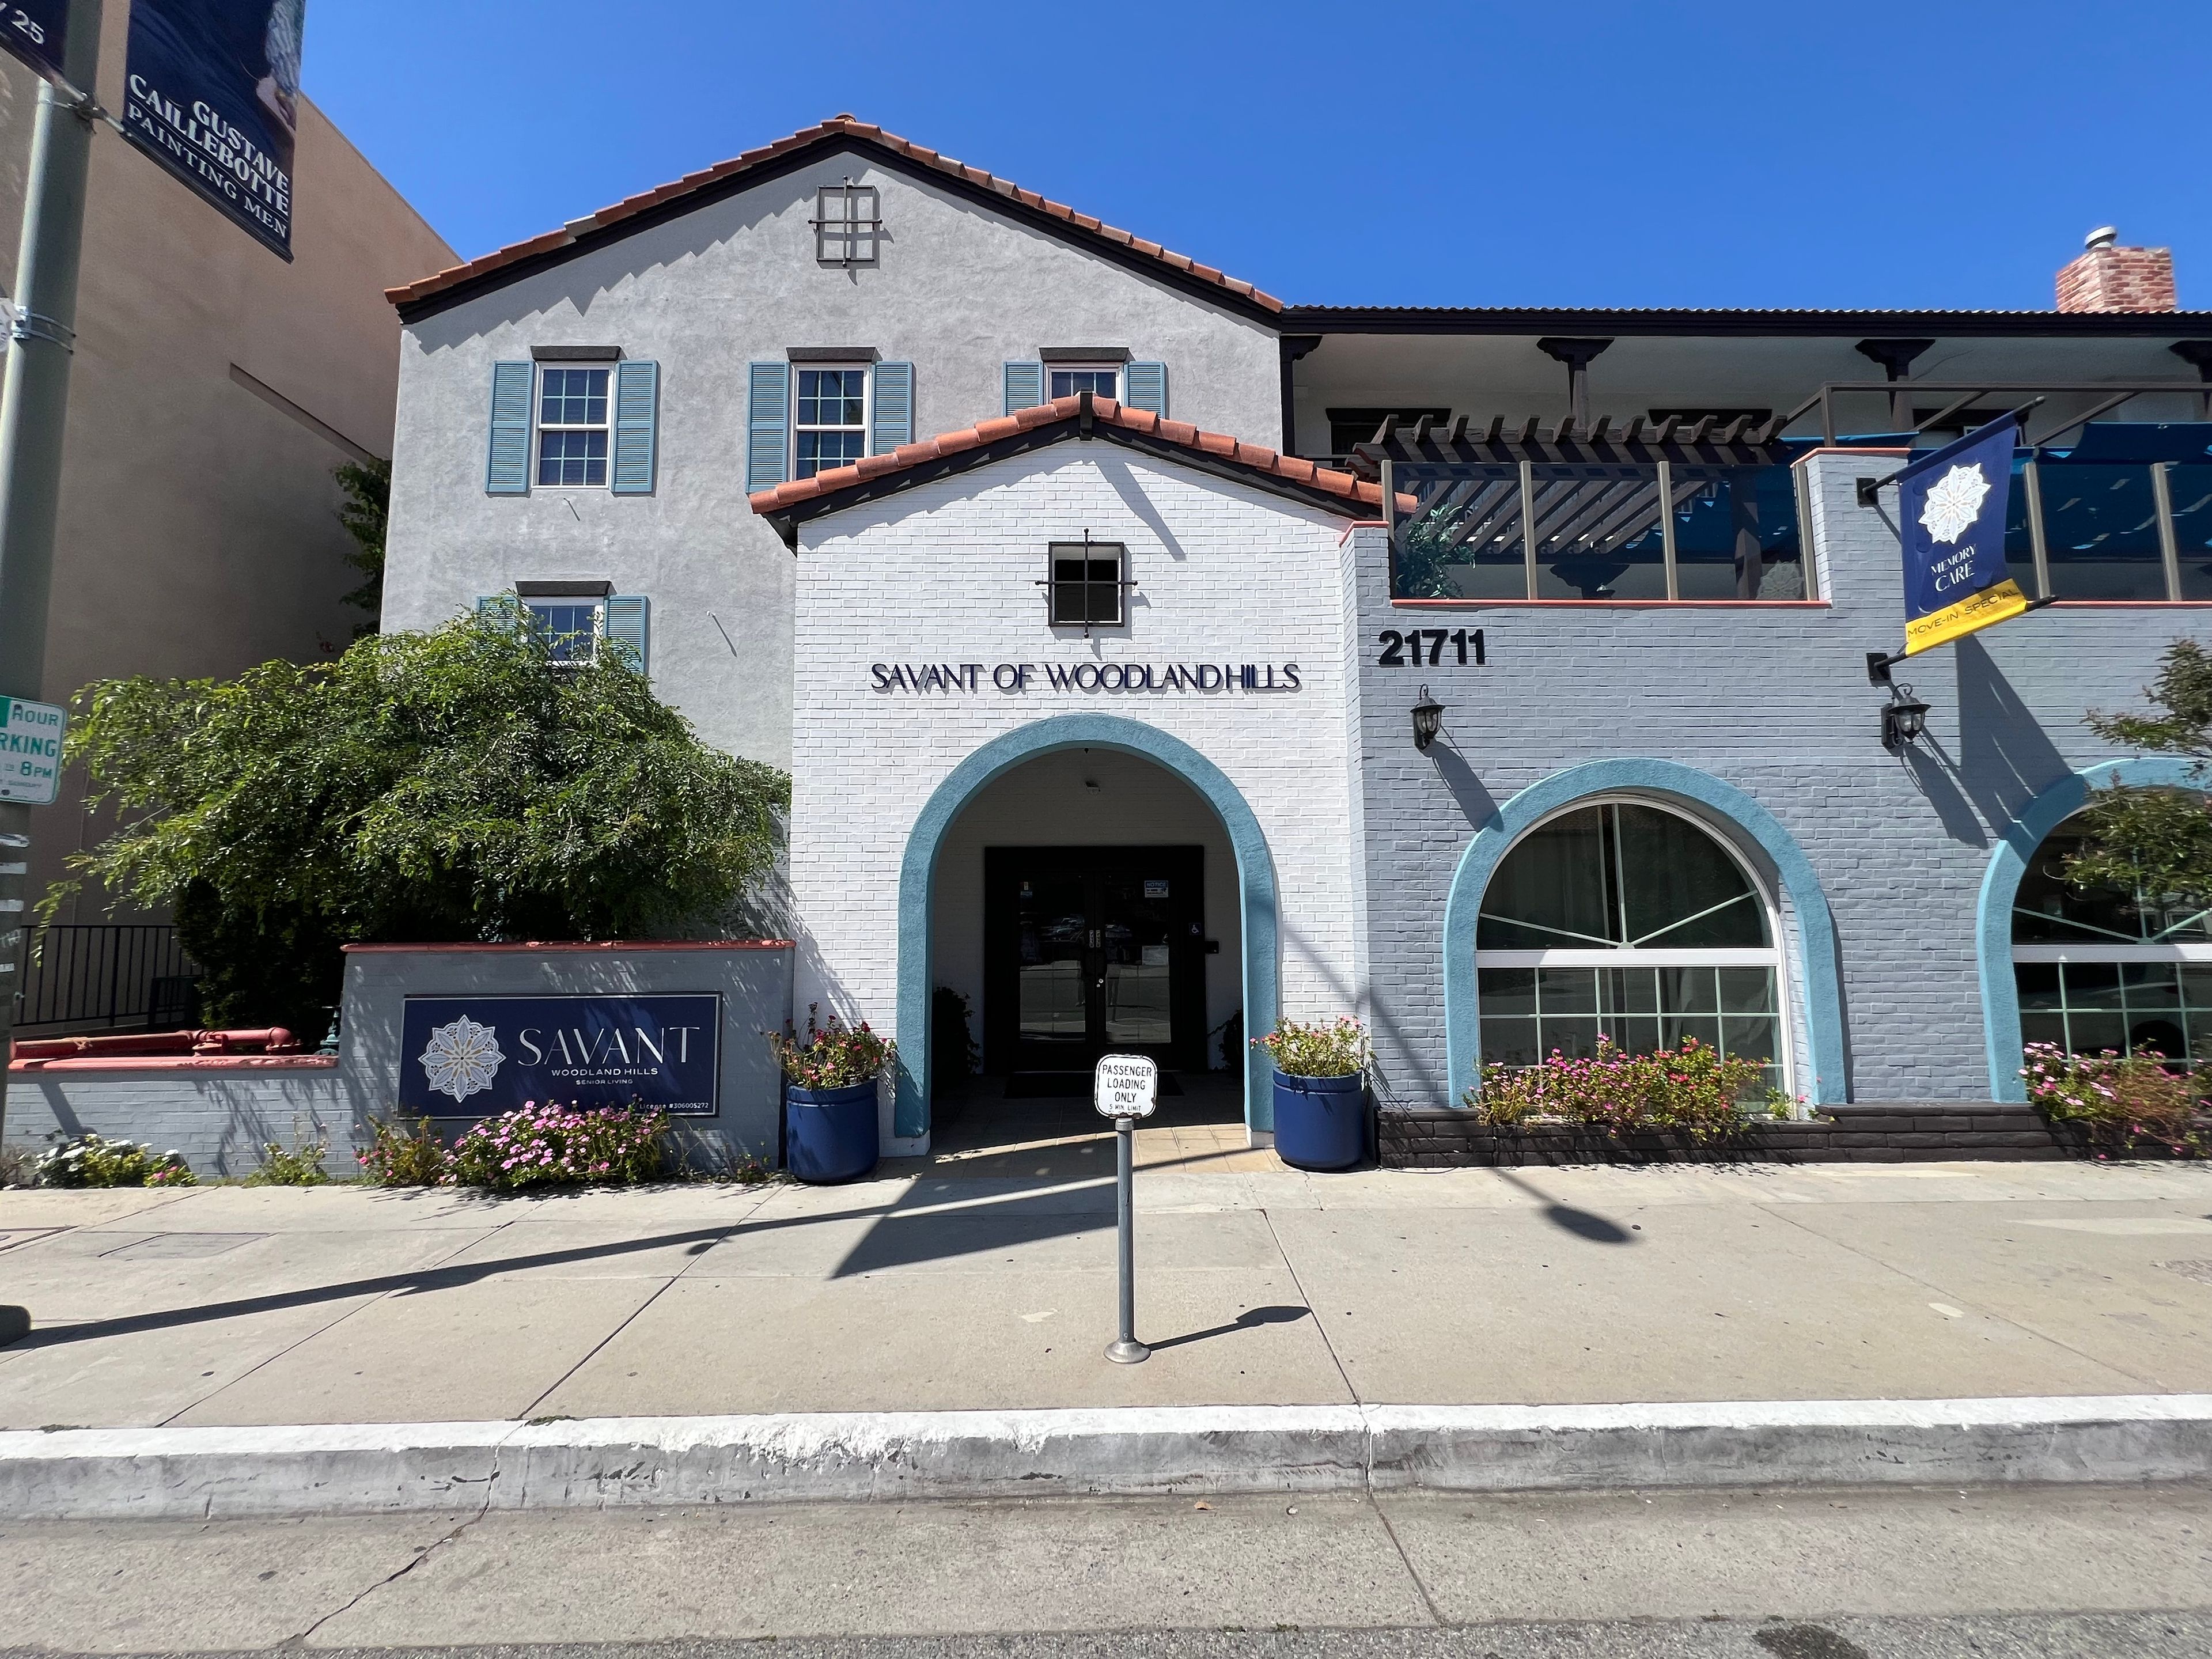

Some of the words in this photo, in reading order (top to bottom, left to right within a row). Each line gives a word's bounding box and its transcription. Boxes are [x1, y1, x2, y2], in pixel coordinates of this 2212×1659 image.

[11, 10, 44, 44] 25
[130, 74, 289, 217] CAILLEBOTTE
[194, 101, 289, 195] GUSTAVE
[128, 103, 237, 199] PAINTING
[244, 196, 287, 238] MEN
[1931, 544, 1976, 575] MEMORY
[1935, 560, 1975, 592] CARE
[1908, 612, 1959, 637] MOVE-IN
[1965, 589, 2019, 615] SPECIAL
[1378, 629, 1485, 666] 21711
[872, 664, 983, 689] SAVANT
[994, 664, 1034, 689] OF
[13, 706, 58, 726] HOUR
[518, 1027, 700, 1066] SAVANT
[551, 1068, 621, 1076] WOODLAND
[1102, 1065, 1152, 1077] PASSENGER
[1107, 1078, 1145, 1090] LOADING
[1115, 1092, 1137, 1103] ONLY
